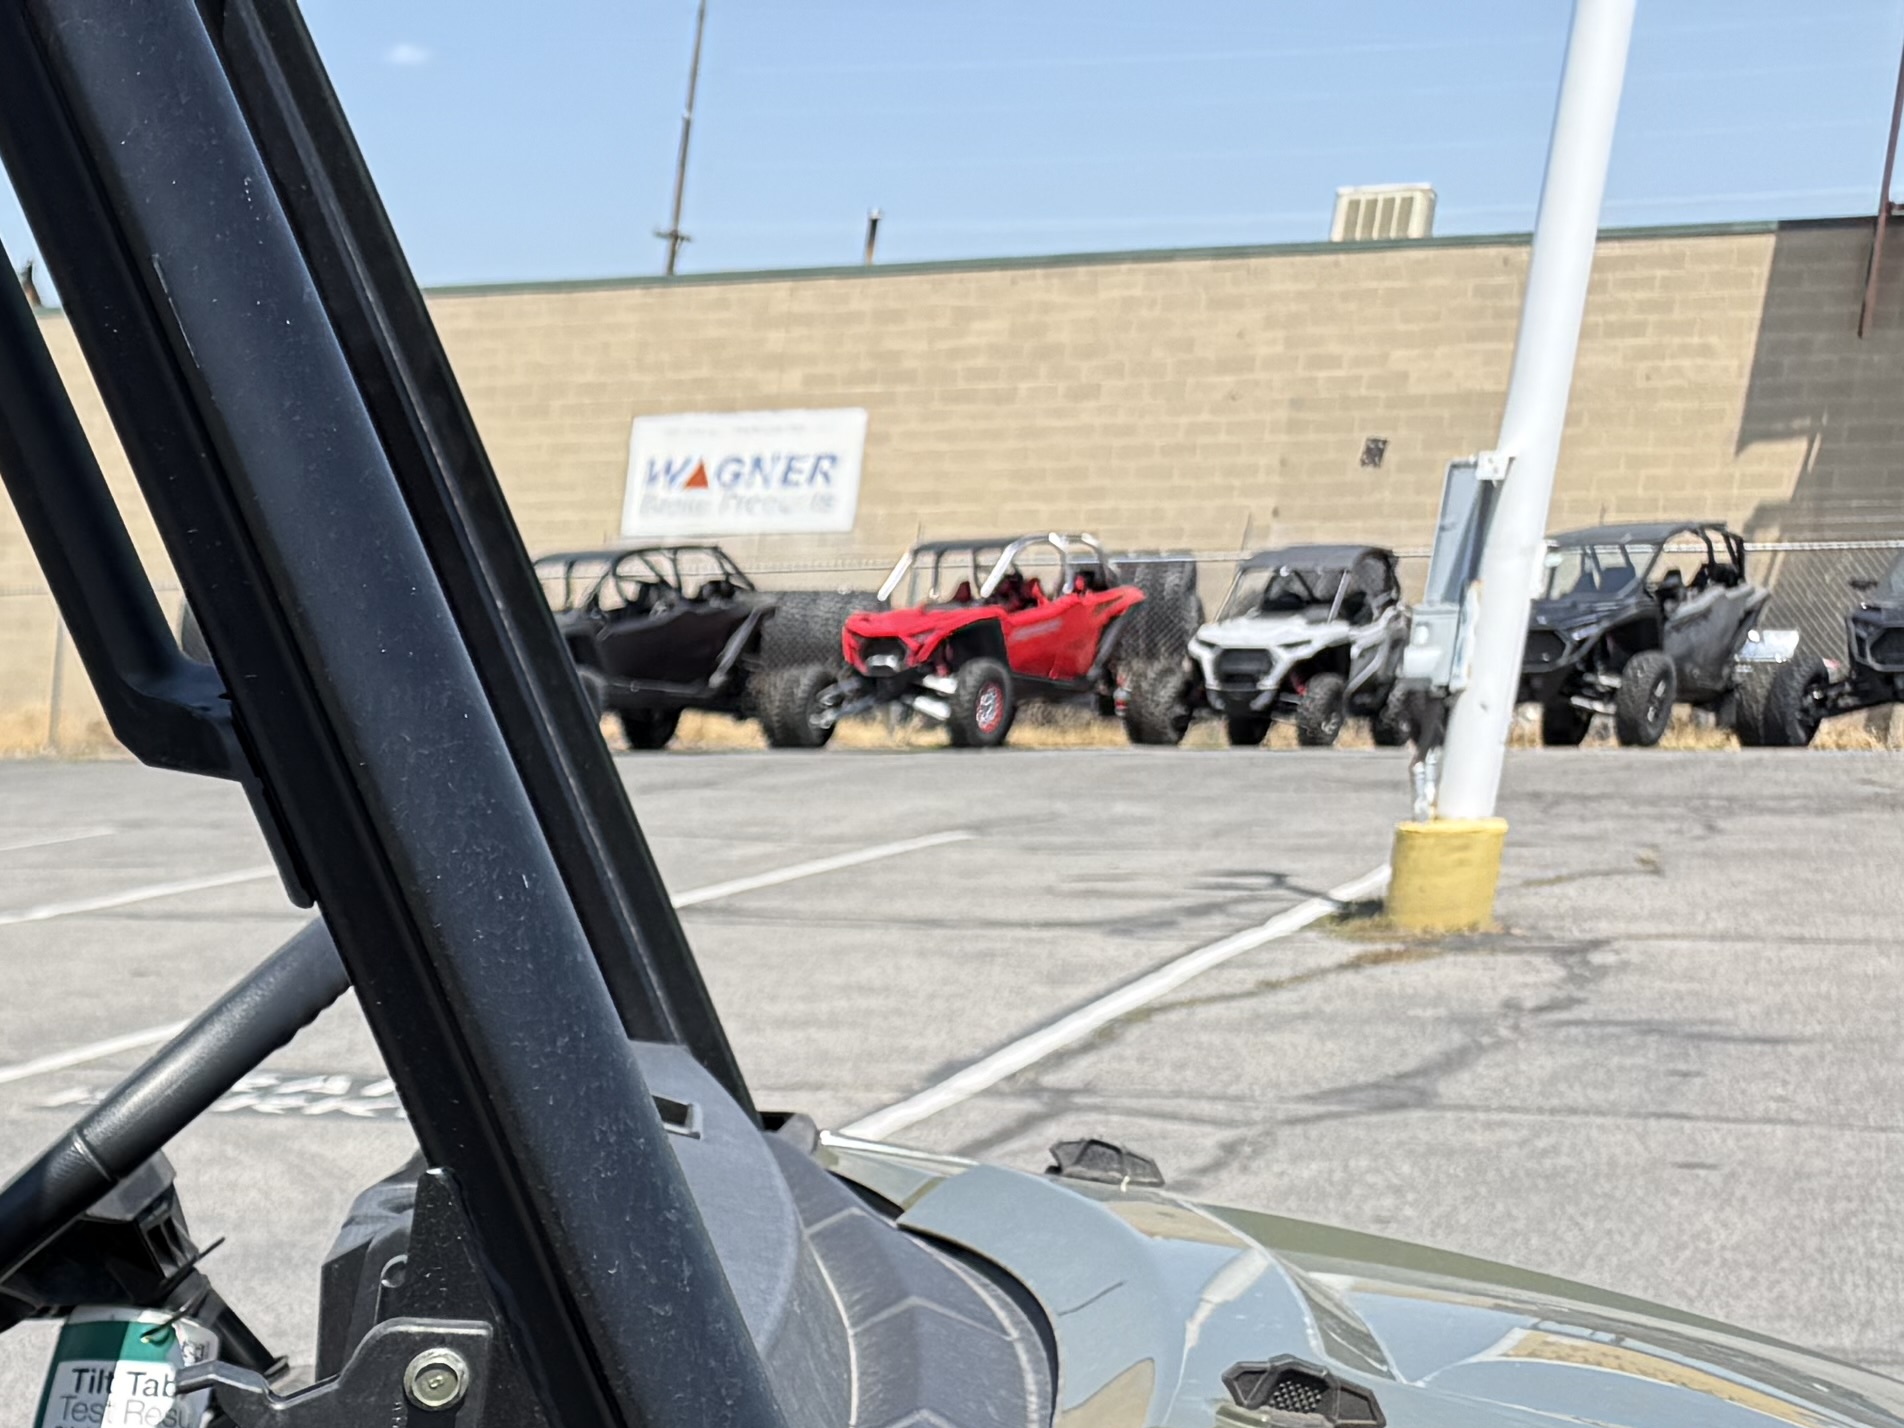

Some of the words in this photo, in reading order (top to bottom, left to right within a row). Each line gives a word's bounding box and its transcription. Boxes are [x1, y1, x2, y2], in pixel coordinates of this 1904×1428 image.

[645, 451, 840, 490] WAGNER
[72, 1368, 114, 1395] Tilt
[126, 1371, 177, 1398] Tab
[60, 1395, 113, 1424] Test
